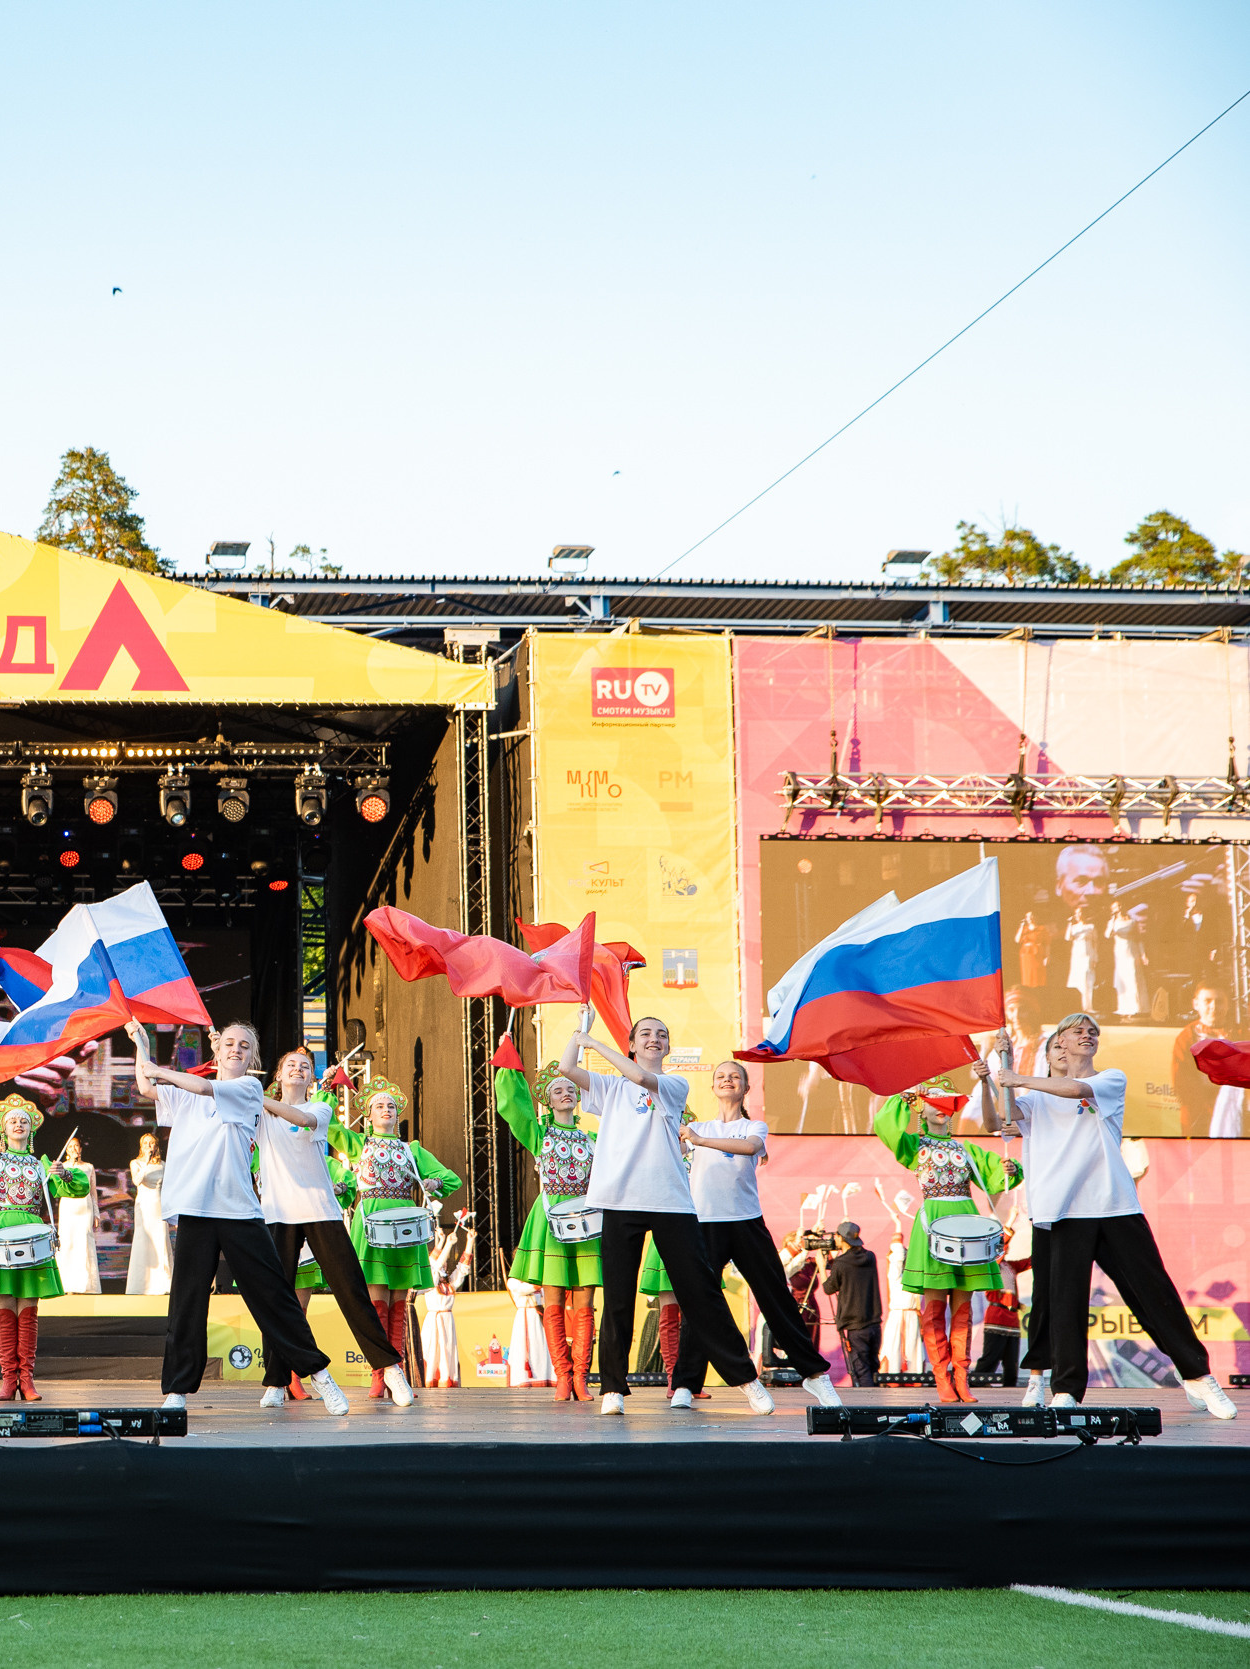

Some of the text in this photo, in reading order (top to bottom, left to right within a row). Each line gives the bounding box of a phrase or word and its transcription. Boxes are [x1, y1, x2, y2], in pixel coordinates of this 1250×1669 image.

[596, 680, 663, 699] RU TV
[597, 707, 670, 716] СМОТРИ МУЗЫКУ!
[591, 721, 649, 729] Информационный
